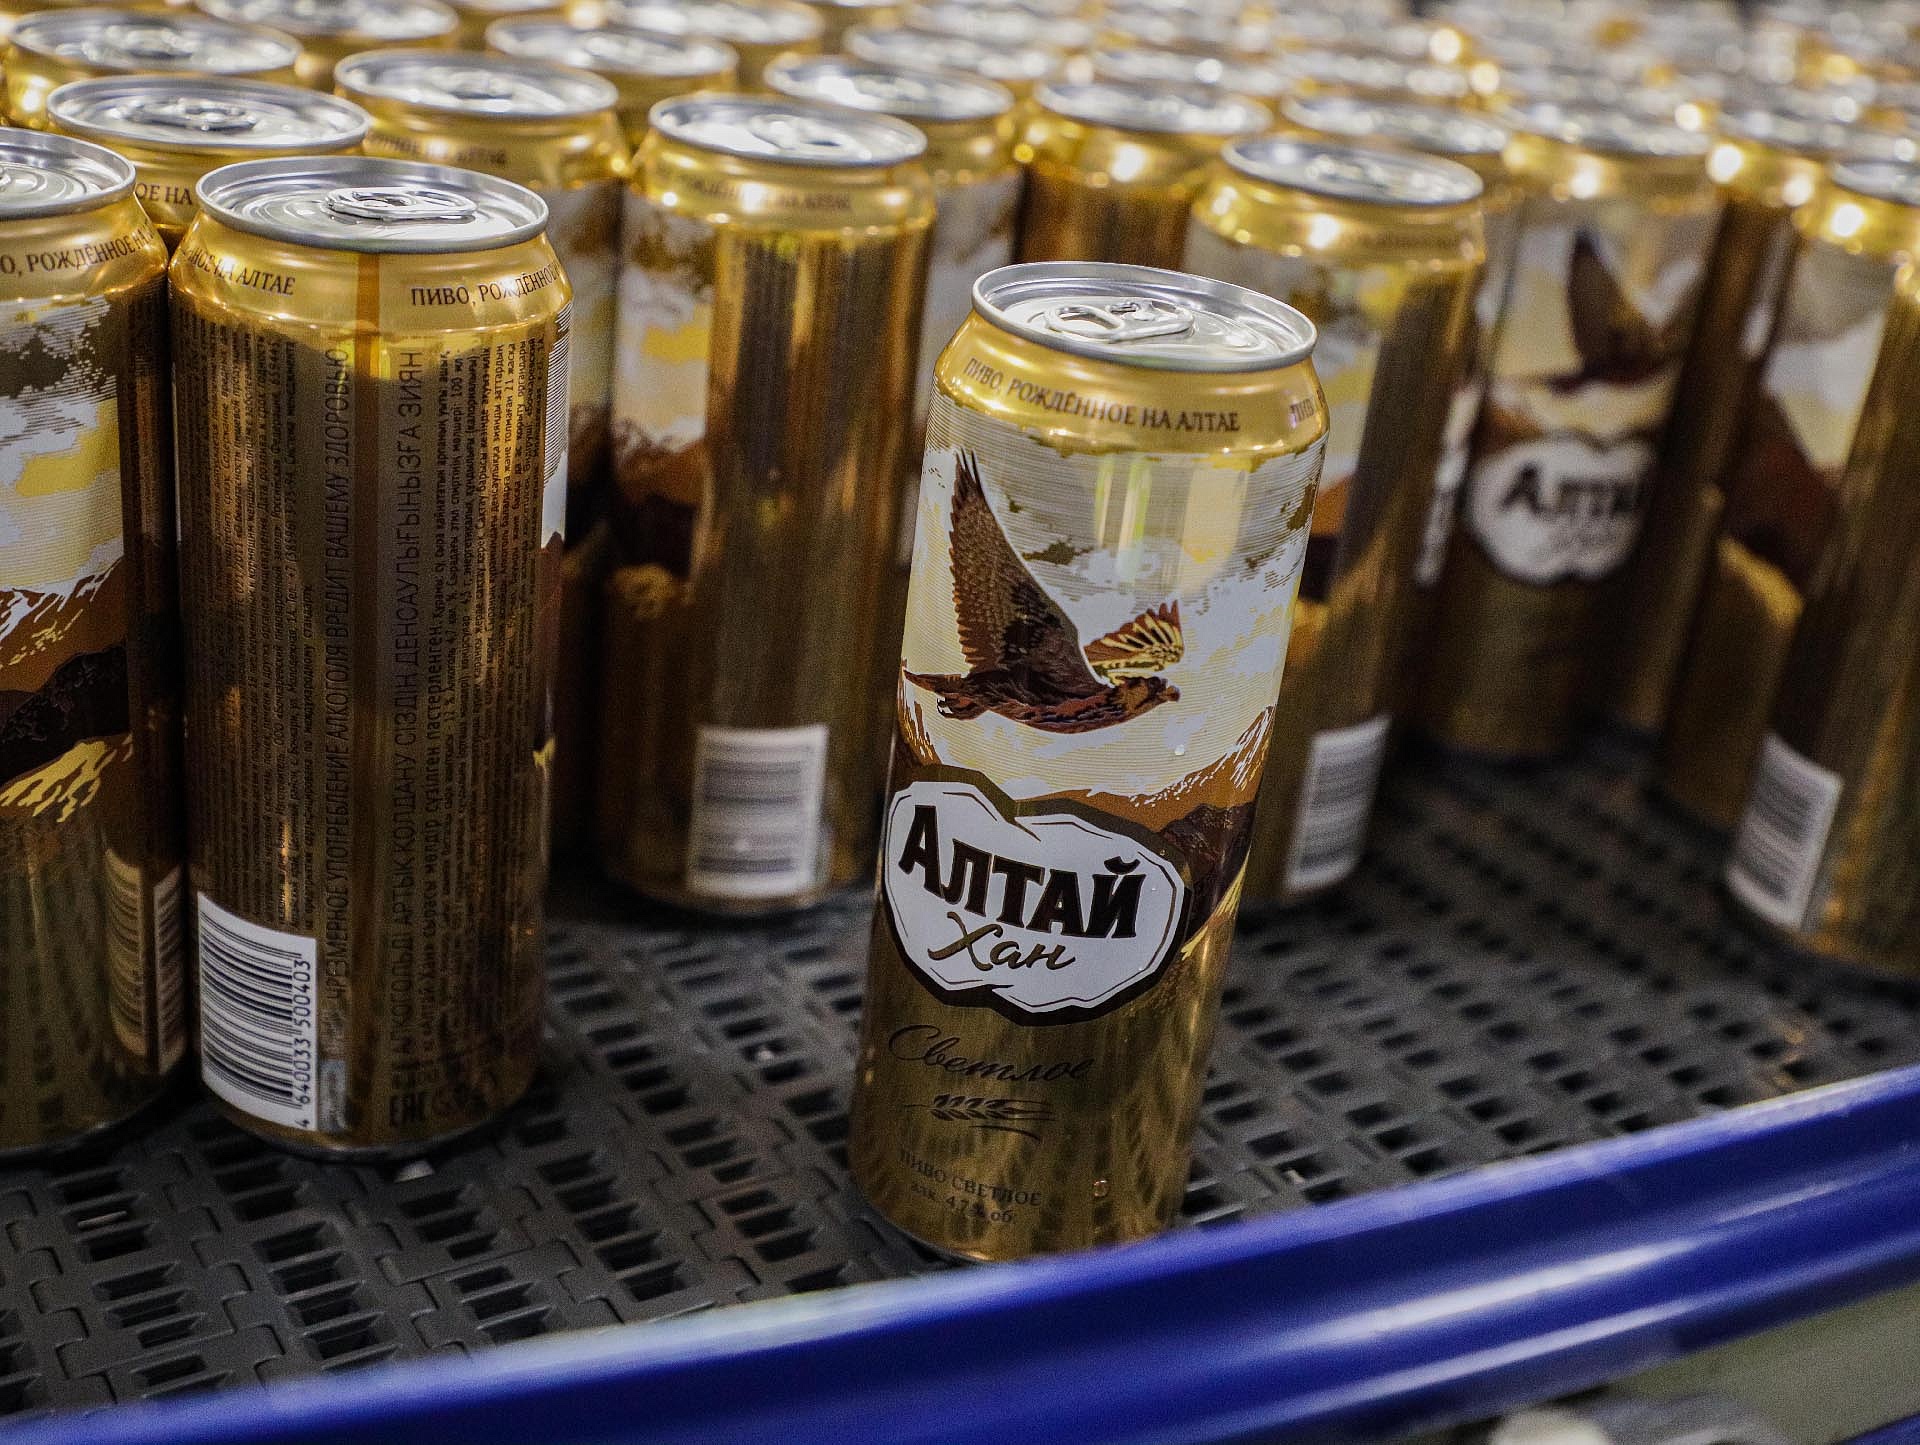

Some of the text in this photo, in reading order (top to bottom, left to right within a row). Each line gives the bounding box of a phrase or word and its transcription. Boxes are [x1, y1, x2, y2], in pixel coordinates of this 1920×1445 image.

[164, 186, 193, 206] НА
[236, 267, 296, 296] АЛТАЕ
[411, 285, 476, 306] ПИВО,
[398, 351, 422, 418] ЗИЯН
[451, 377, 463, 398] 100
[504, 379, 514, 391] 21
[963, 357, 1241, 433] ПИВО, РОЖДЁННОЕ НА АЛТАЕ
[303, 644, 315, 734] международному
[325, 349, 349, 999] ЧРЕЗМЕРНОЕ УПОТРЕБЛЕНИЕ АЛКОГОЛЯ ВРЕДИТ ВАШЕМУ ЗДОРОВЬЮ
[273, 723, 284, 745] ООО
[898, 804, 1146, 939] АЛТАЙ
[927, 911, 1076, 971] Хан
[292, 959, 311, 1127] 4 640033 500403
[888, 1024, 1095, 1082] Светлое
[901, 1151, 1042, 1206] ПИВО СВЕТЛОЕ
